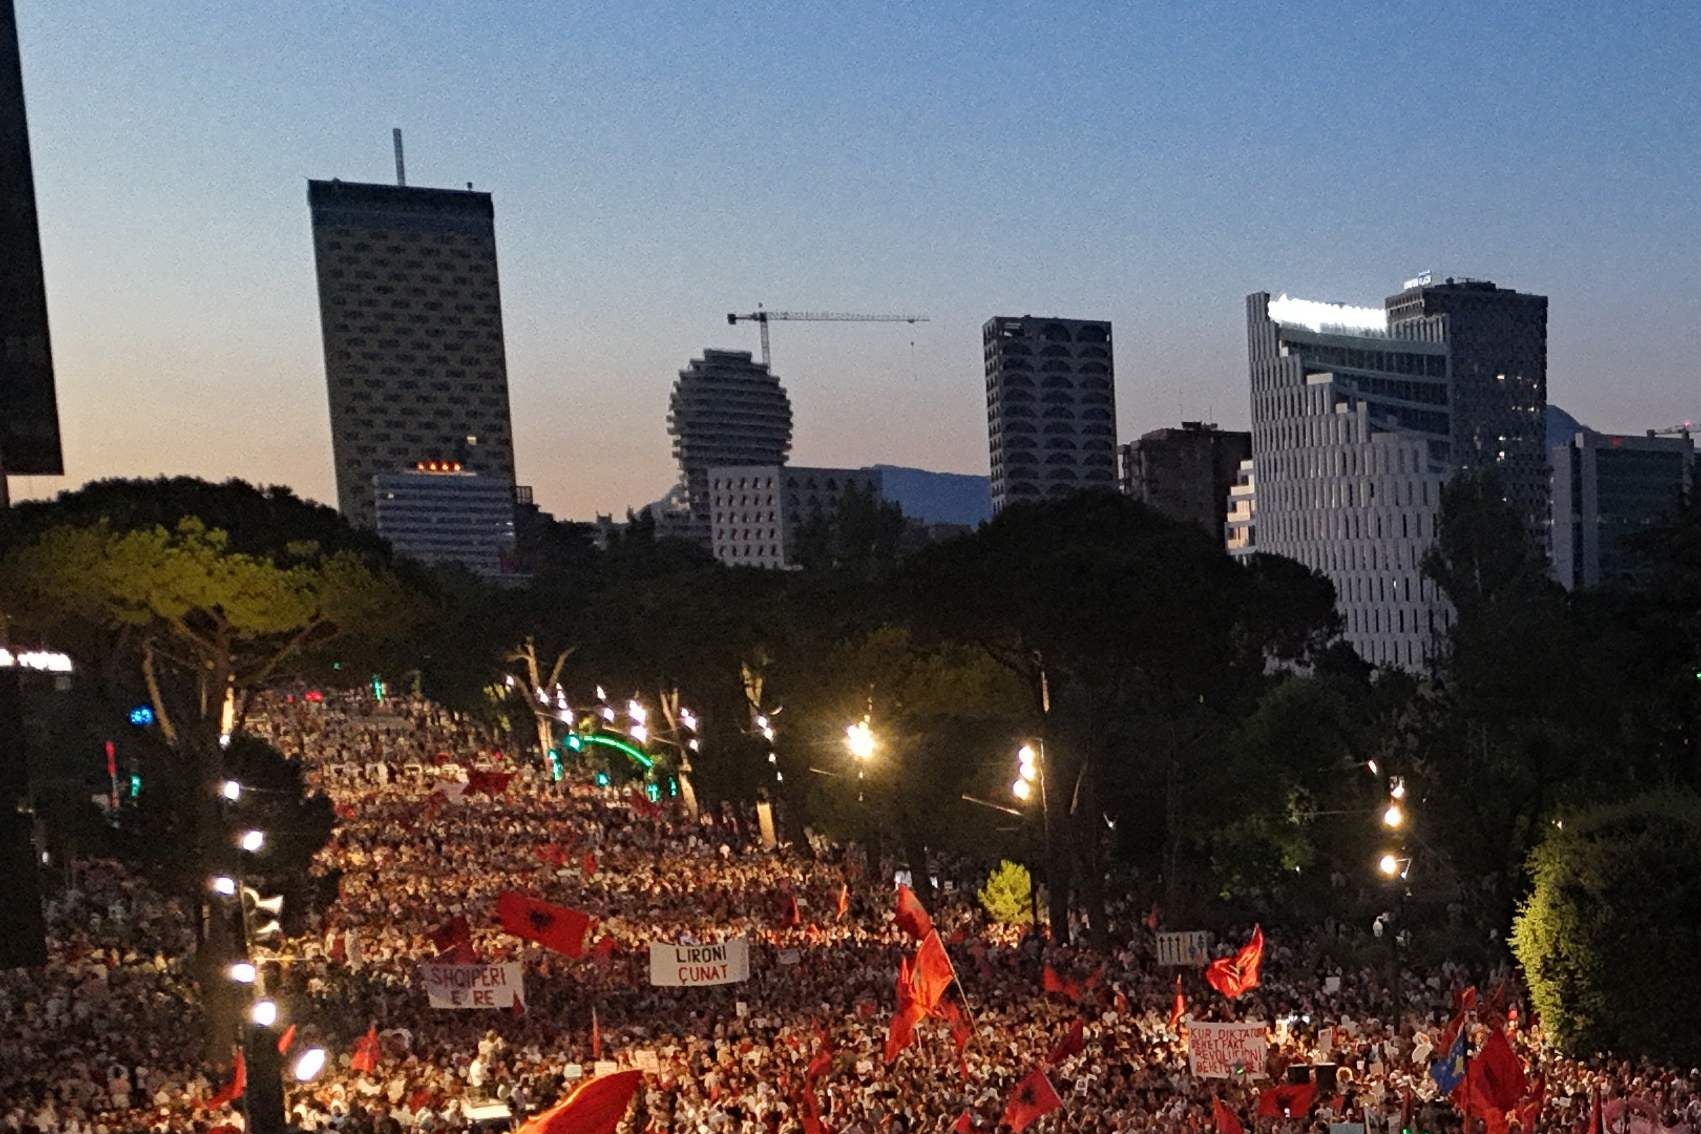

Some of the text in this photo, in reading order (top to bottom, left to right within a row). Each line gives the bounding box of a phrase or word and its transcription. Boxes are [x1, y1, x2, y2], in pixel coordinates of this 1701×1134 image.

[676, 945, 727, 963] LIRONI
[431, 966, 507, 989] SHQIPERI
[678, 964, 728, 985] ÇUNAT
[451, 989, 495, 1006] E RE
[1190, 1028, 1212, 1040] KUR
[1222, 1039, 1246, 1050] FAKT
